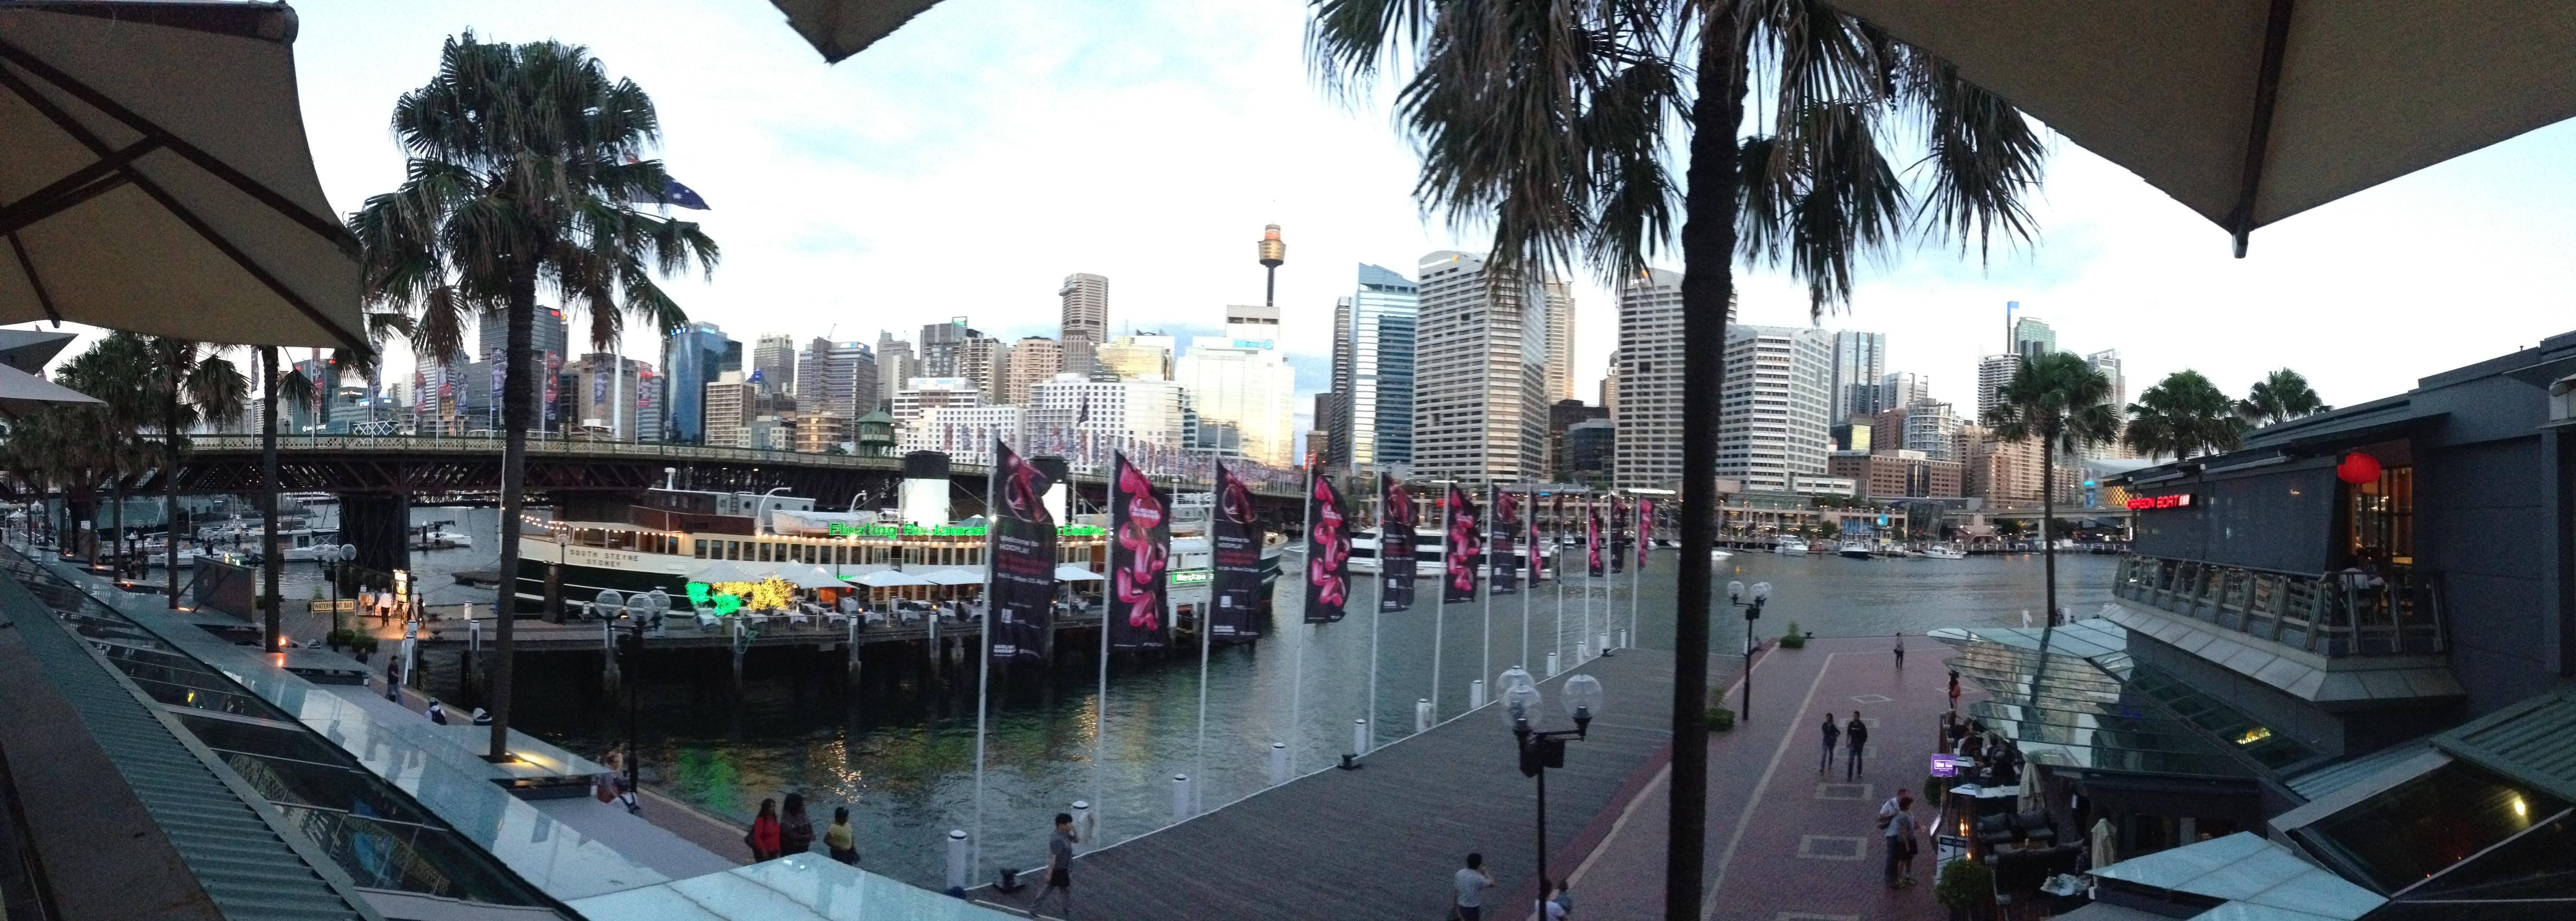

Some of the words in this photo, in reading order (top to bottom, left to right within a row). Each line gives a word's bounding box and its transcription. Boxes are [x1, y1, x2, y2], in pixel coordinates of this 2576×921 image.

[2126, 498, 2155, 509] DRAGON
[2156, 495, 2179, 508] BOAT
[829, 523, 897, 539] Floating
[903, 523, 987, 536] Restaurant
[1063, 524, 1106, 536] Centre
[570, 549, 598, 557] SOUTH
[604, 553, 639, 561] STEYNE
[586, 559, 621, 567] SYDNEY
